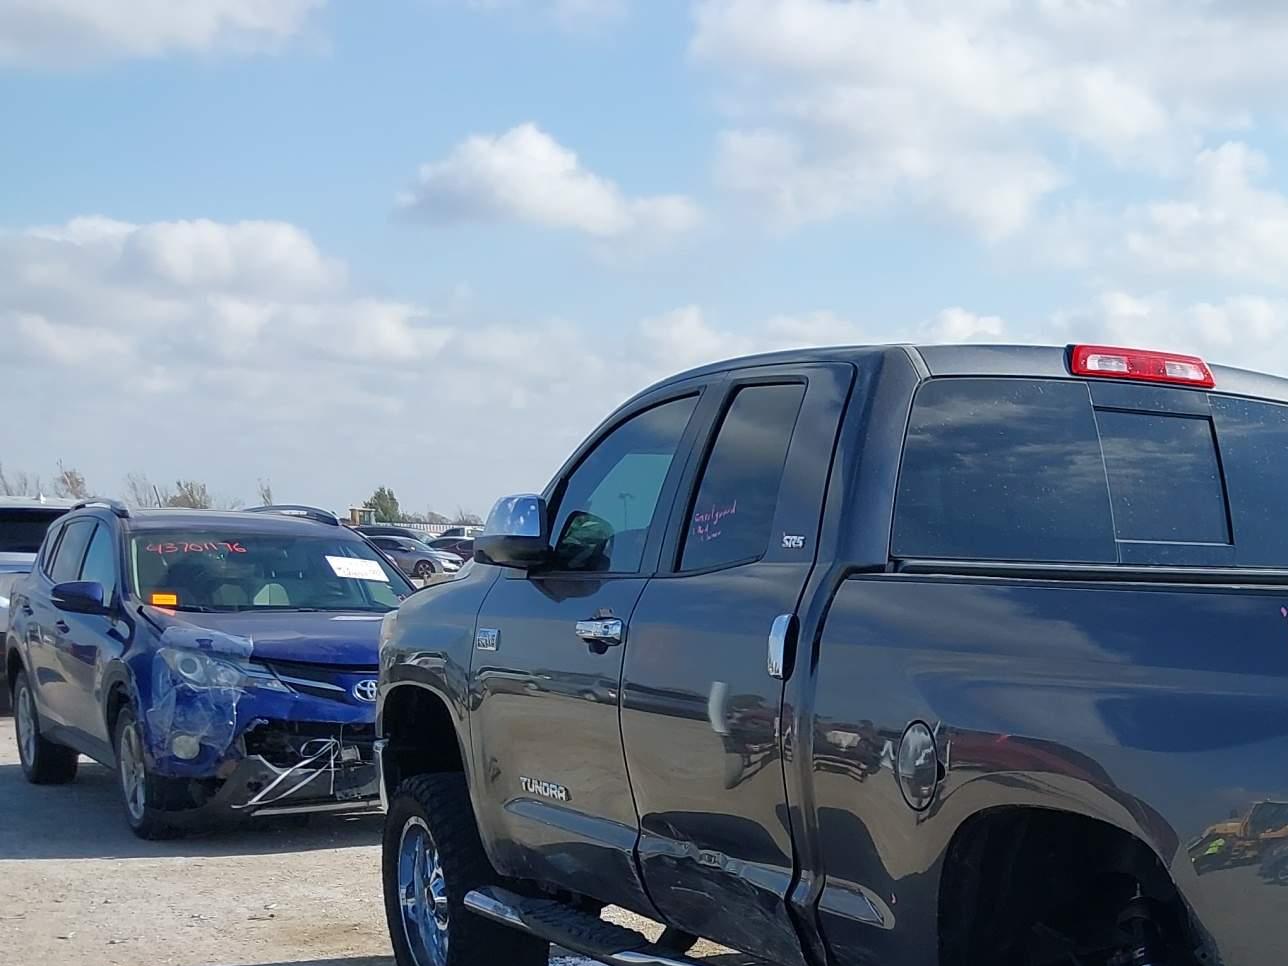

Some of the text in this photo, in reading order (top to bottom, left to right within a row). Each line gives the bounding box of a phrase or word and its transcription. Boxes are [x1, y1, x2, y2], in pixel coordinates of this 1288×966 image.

[782, 535, 805, 548] SR5
[146, 542, 247, 555] 43701176
[519, 776, 567, 801] TUNDRA
